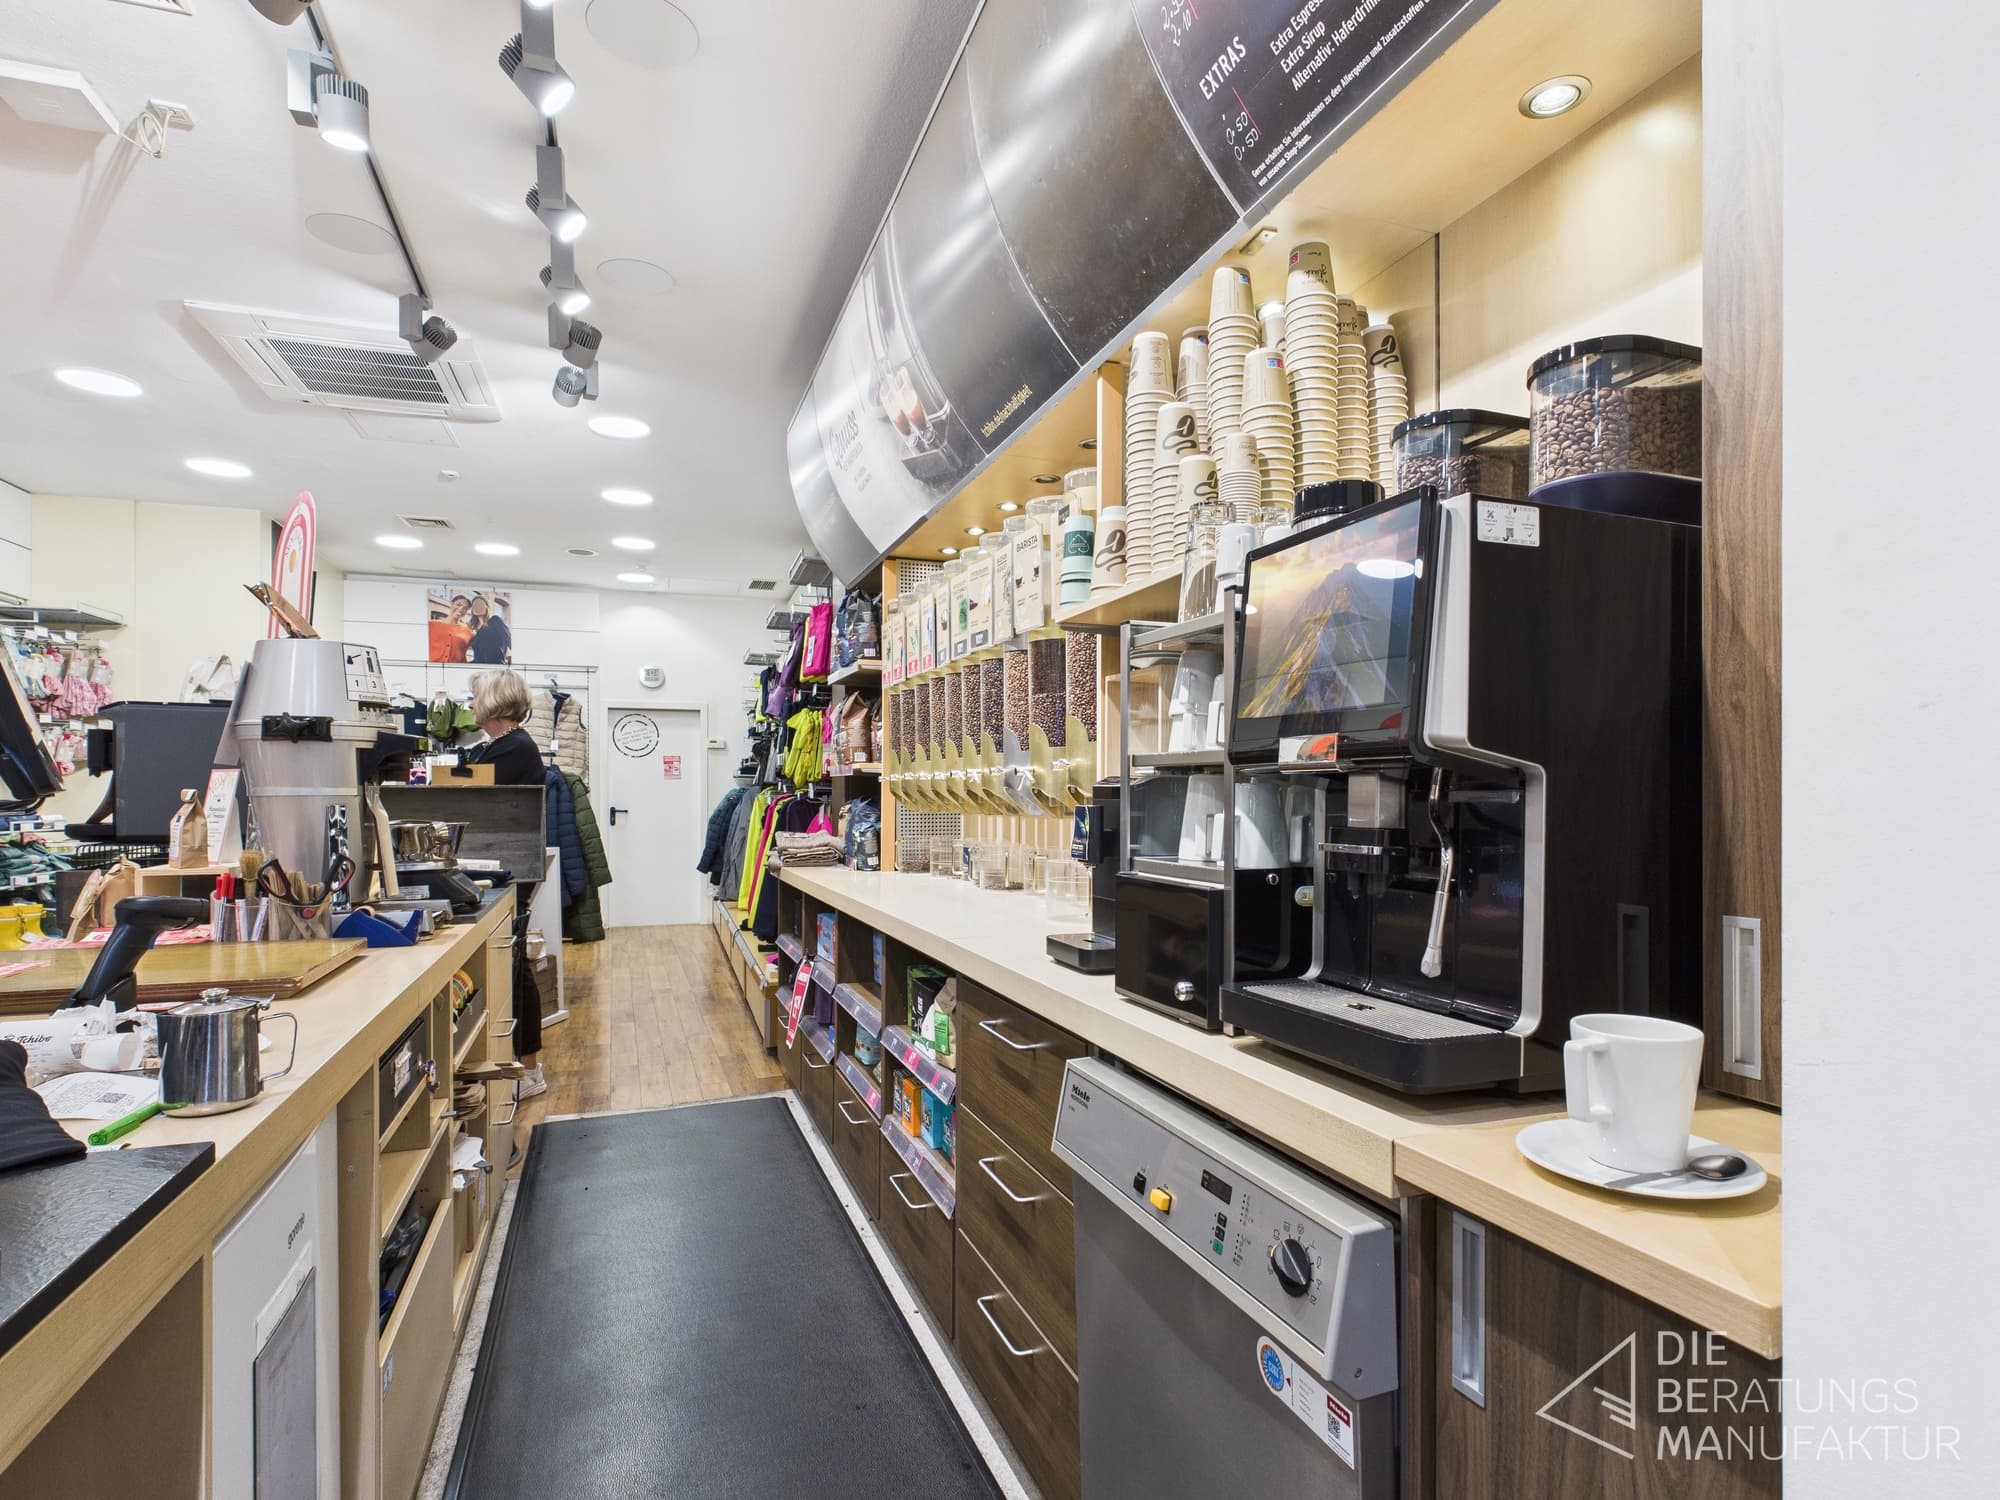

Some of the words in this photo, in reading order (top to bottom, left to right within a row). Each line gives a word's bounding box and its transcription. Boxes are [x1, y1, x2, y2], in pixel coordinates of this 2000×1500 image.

[1270, 27, 1294, 56] Extra
[1280, 44, 1304, 73] Extra
[1301, 21, 1326, 49] Sirup
[1199, 35, 1246, 100] EXTRAS
[1291, 43, 1336, 91] Alternativ:
[1251, 163, 1267, 178] Gerne
[1264, 143, 1285, 164] erhalten
[1282, 135, 1292, 147] Sie
[1290, 102, 1326, 140] Informationen
[1323, 95, 1332, 105] zu
[1331, 84, 1343, 98] den
[1340, 55, 1372, 89] Allergenen
[1370, 41, 1383, 58] und
[1380, 2, 1425, 46] Zusatzstoffen
[1016, 534, 1038, 553] BARISTA
[17, 1034, 54, 1044] Tchibo
[1071, 1083, 1090, 1103] Miele
